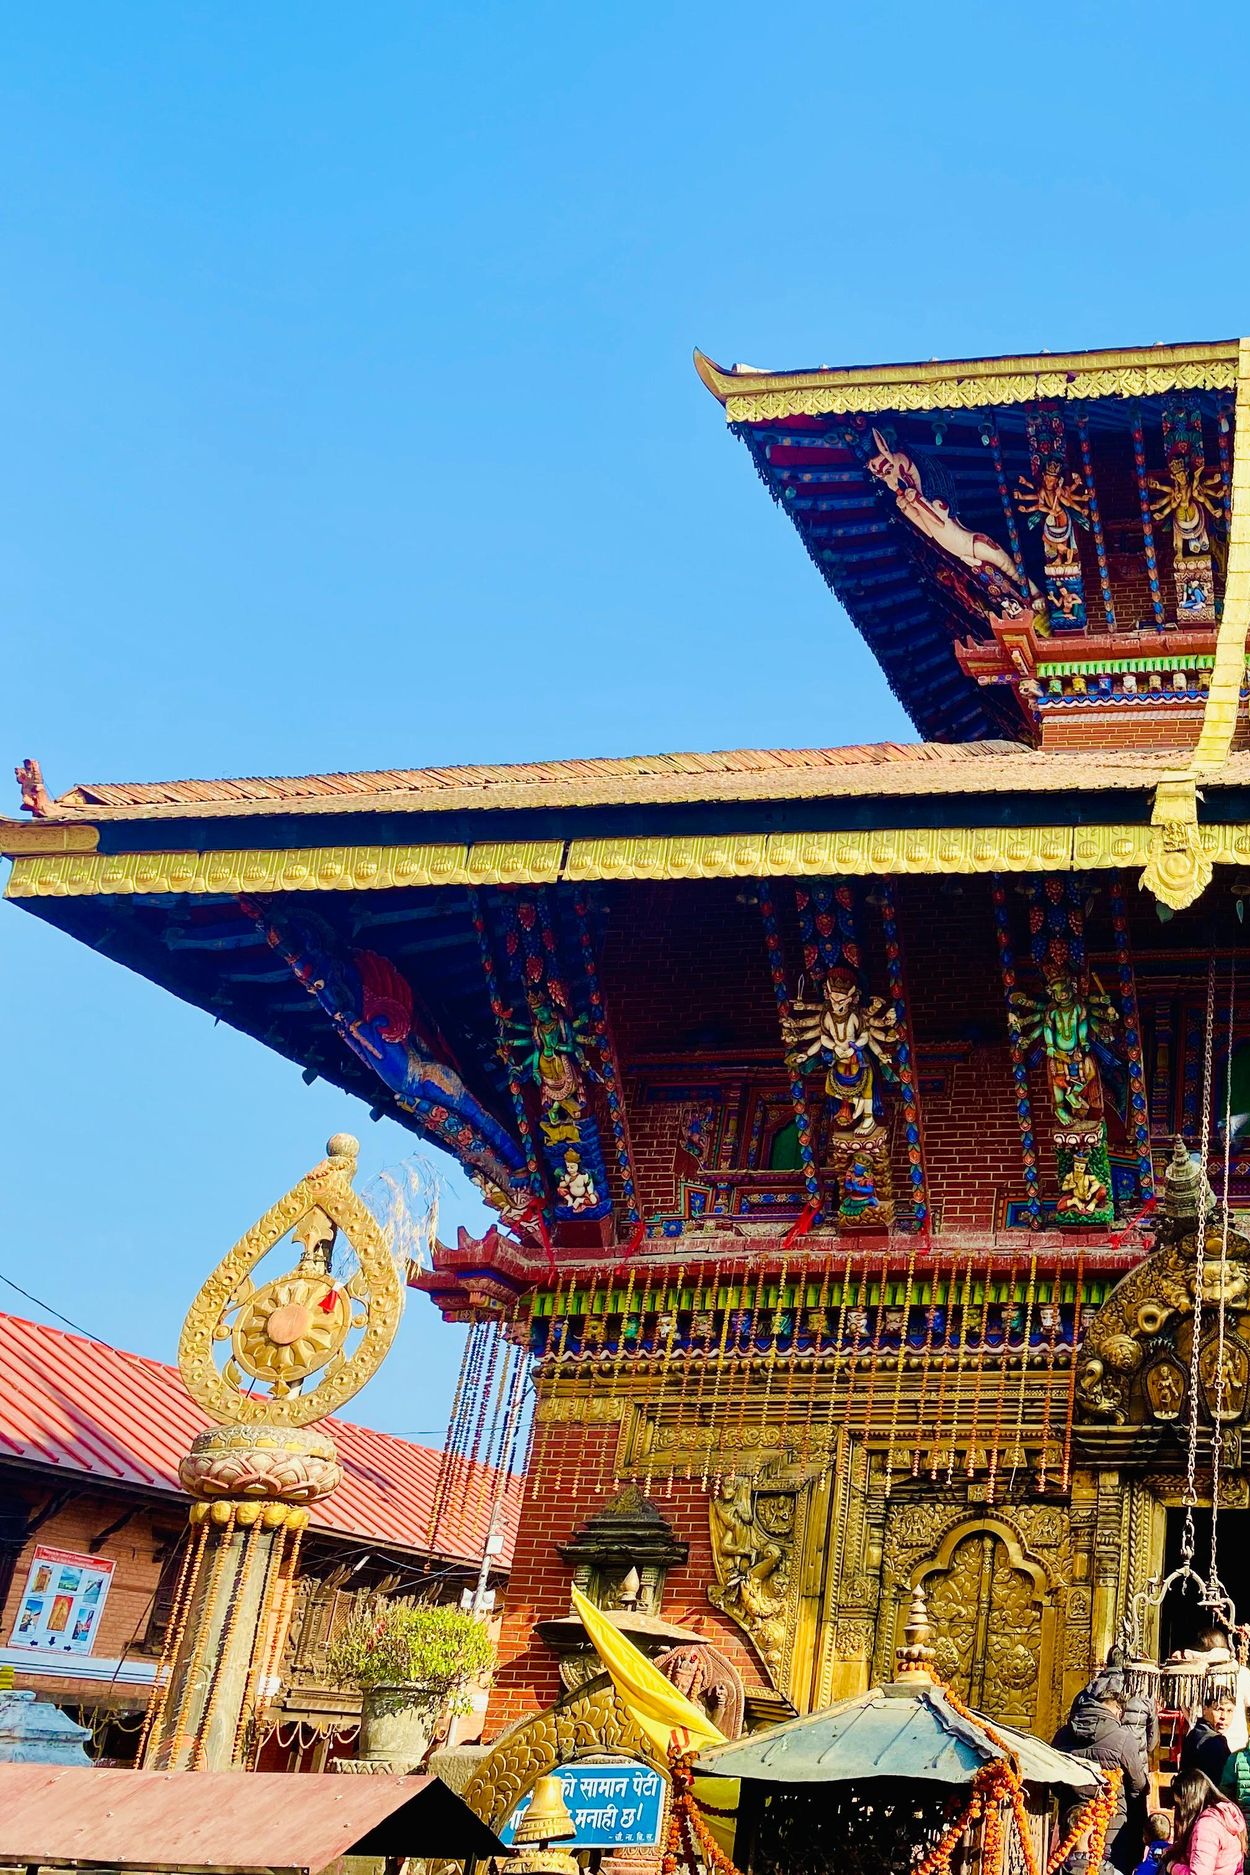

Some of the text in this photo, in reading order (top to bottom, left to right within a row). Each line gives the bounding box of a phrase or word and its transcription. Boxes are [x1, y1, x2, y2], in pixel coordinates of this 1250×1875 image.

[580, 1777, 629, 1801] सामान
[633, 1771, 660, 1797] पेटी
[575, 1803, 618, 1831] मनाही
